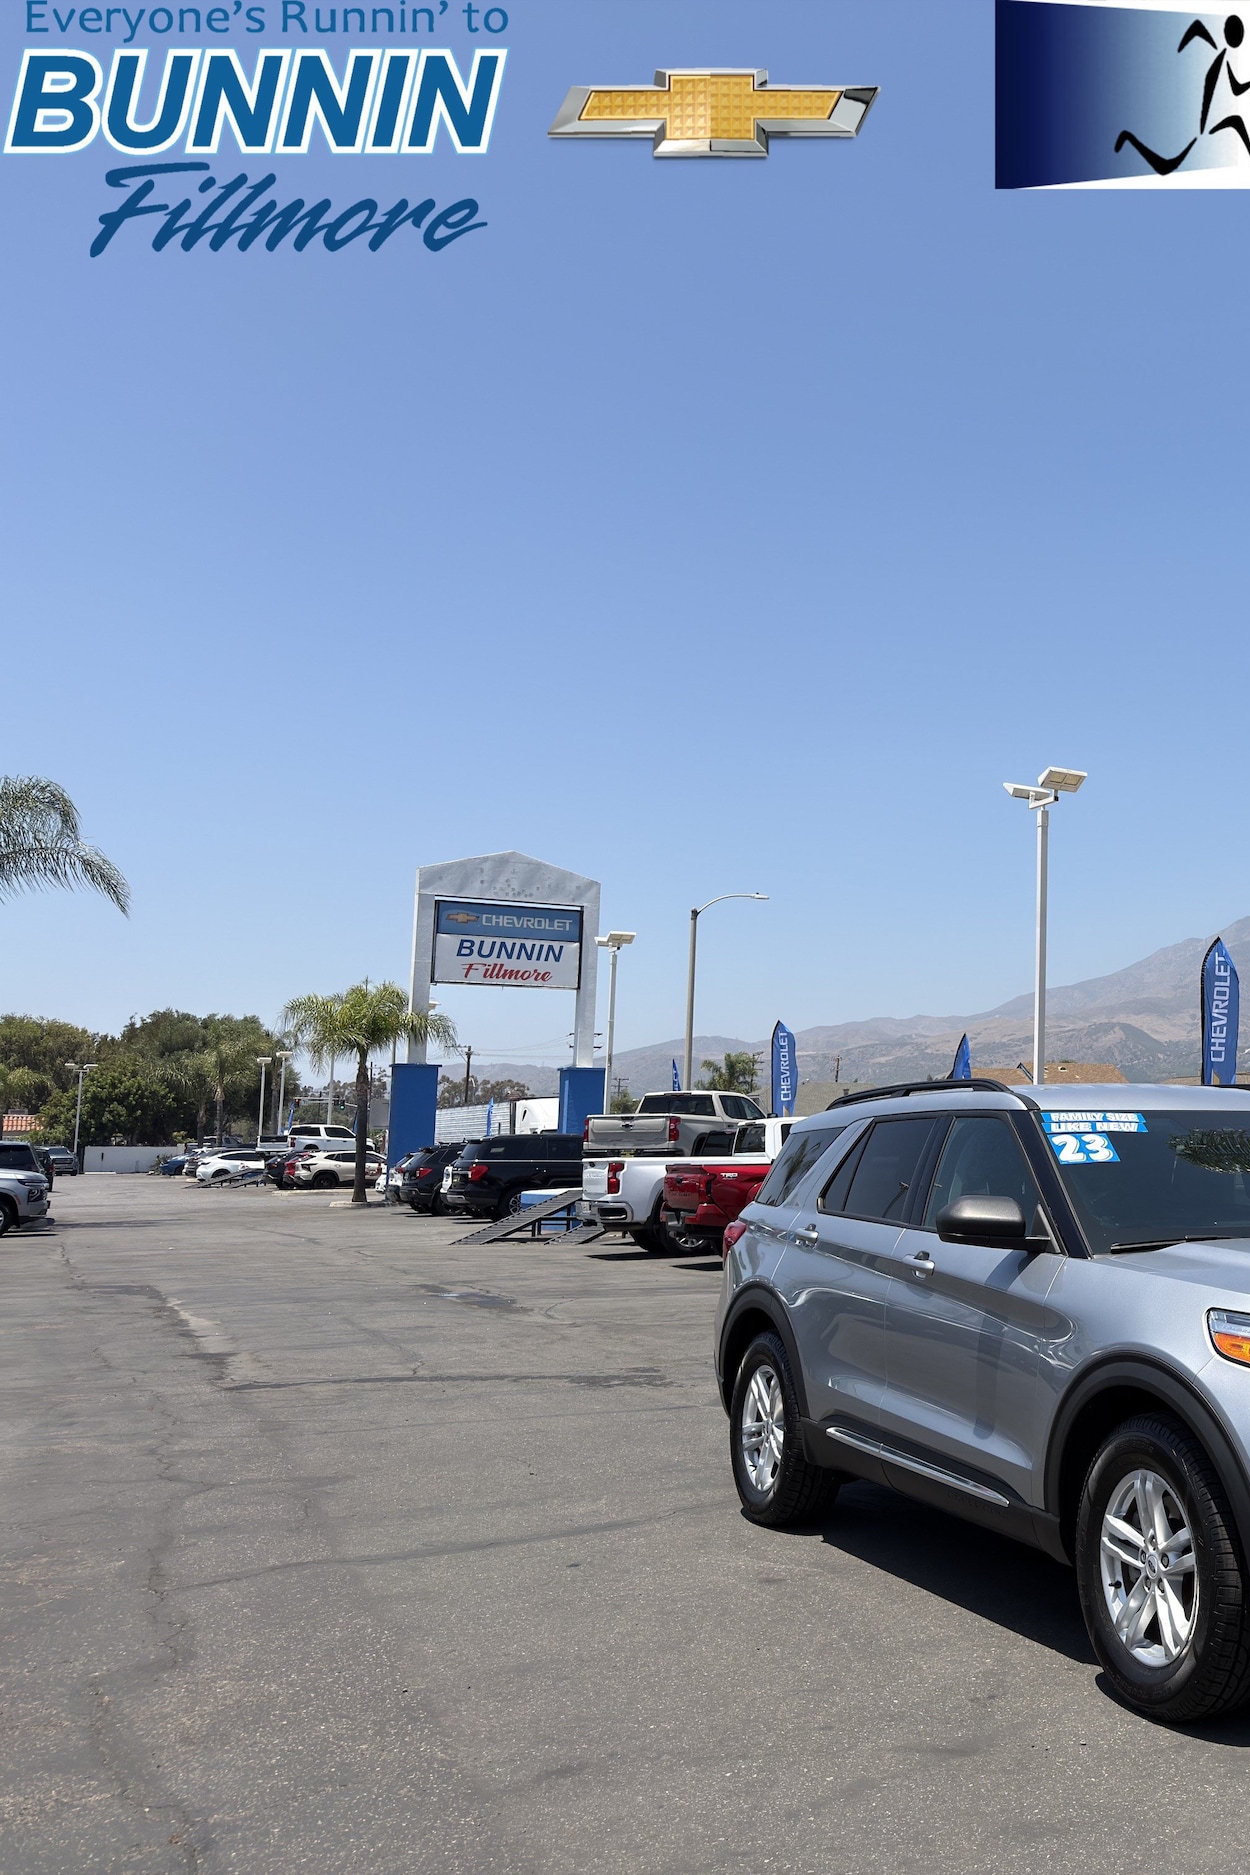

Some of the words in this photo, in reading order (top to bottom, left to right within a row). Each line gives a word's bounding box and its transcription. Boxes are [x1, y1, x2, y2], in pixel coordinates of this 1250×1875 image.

[482, 914, 573, 931] CHEVROLET
[456, 939, 564, 963] BUNNIN
[461, 963, 553, 982] Fillmore
[1210, 951, 1231, 1062] CHEVROLET
[778, 1030, 792, 1101] CHEVROLET
[1050, 1112, 1103, 1121] FAMILY
[1106, 1112, 1140, 1122] SIZE
[1050, 1122, 1093, 1132] LIKE
[1096, 1122, 1138, 1132] NEW
[1051, 1134, 1113, 1162] 23
